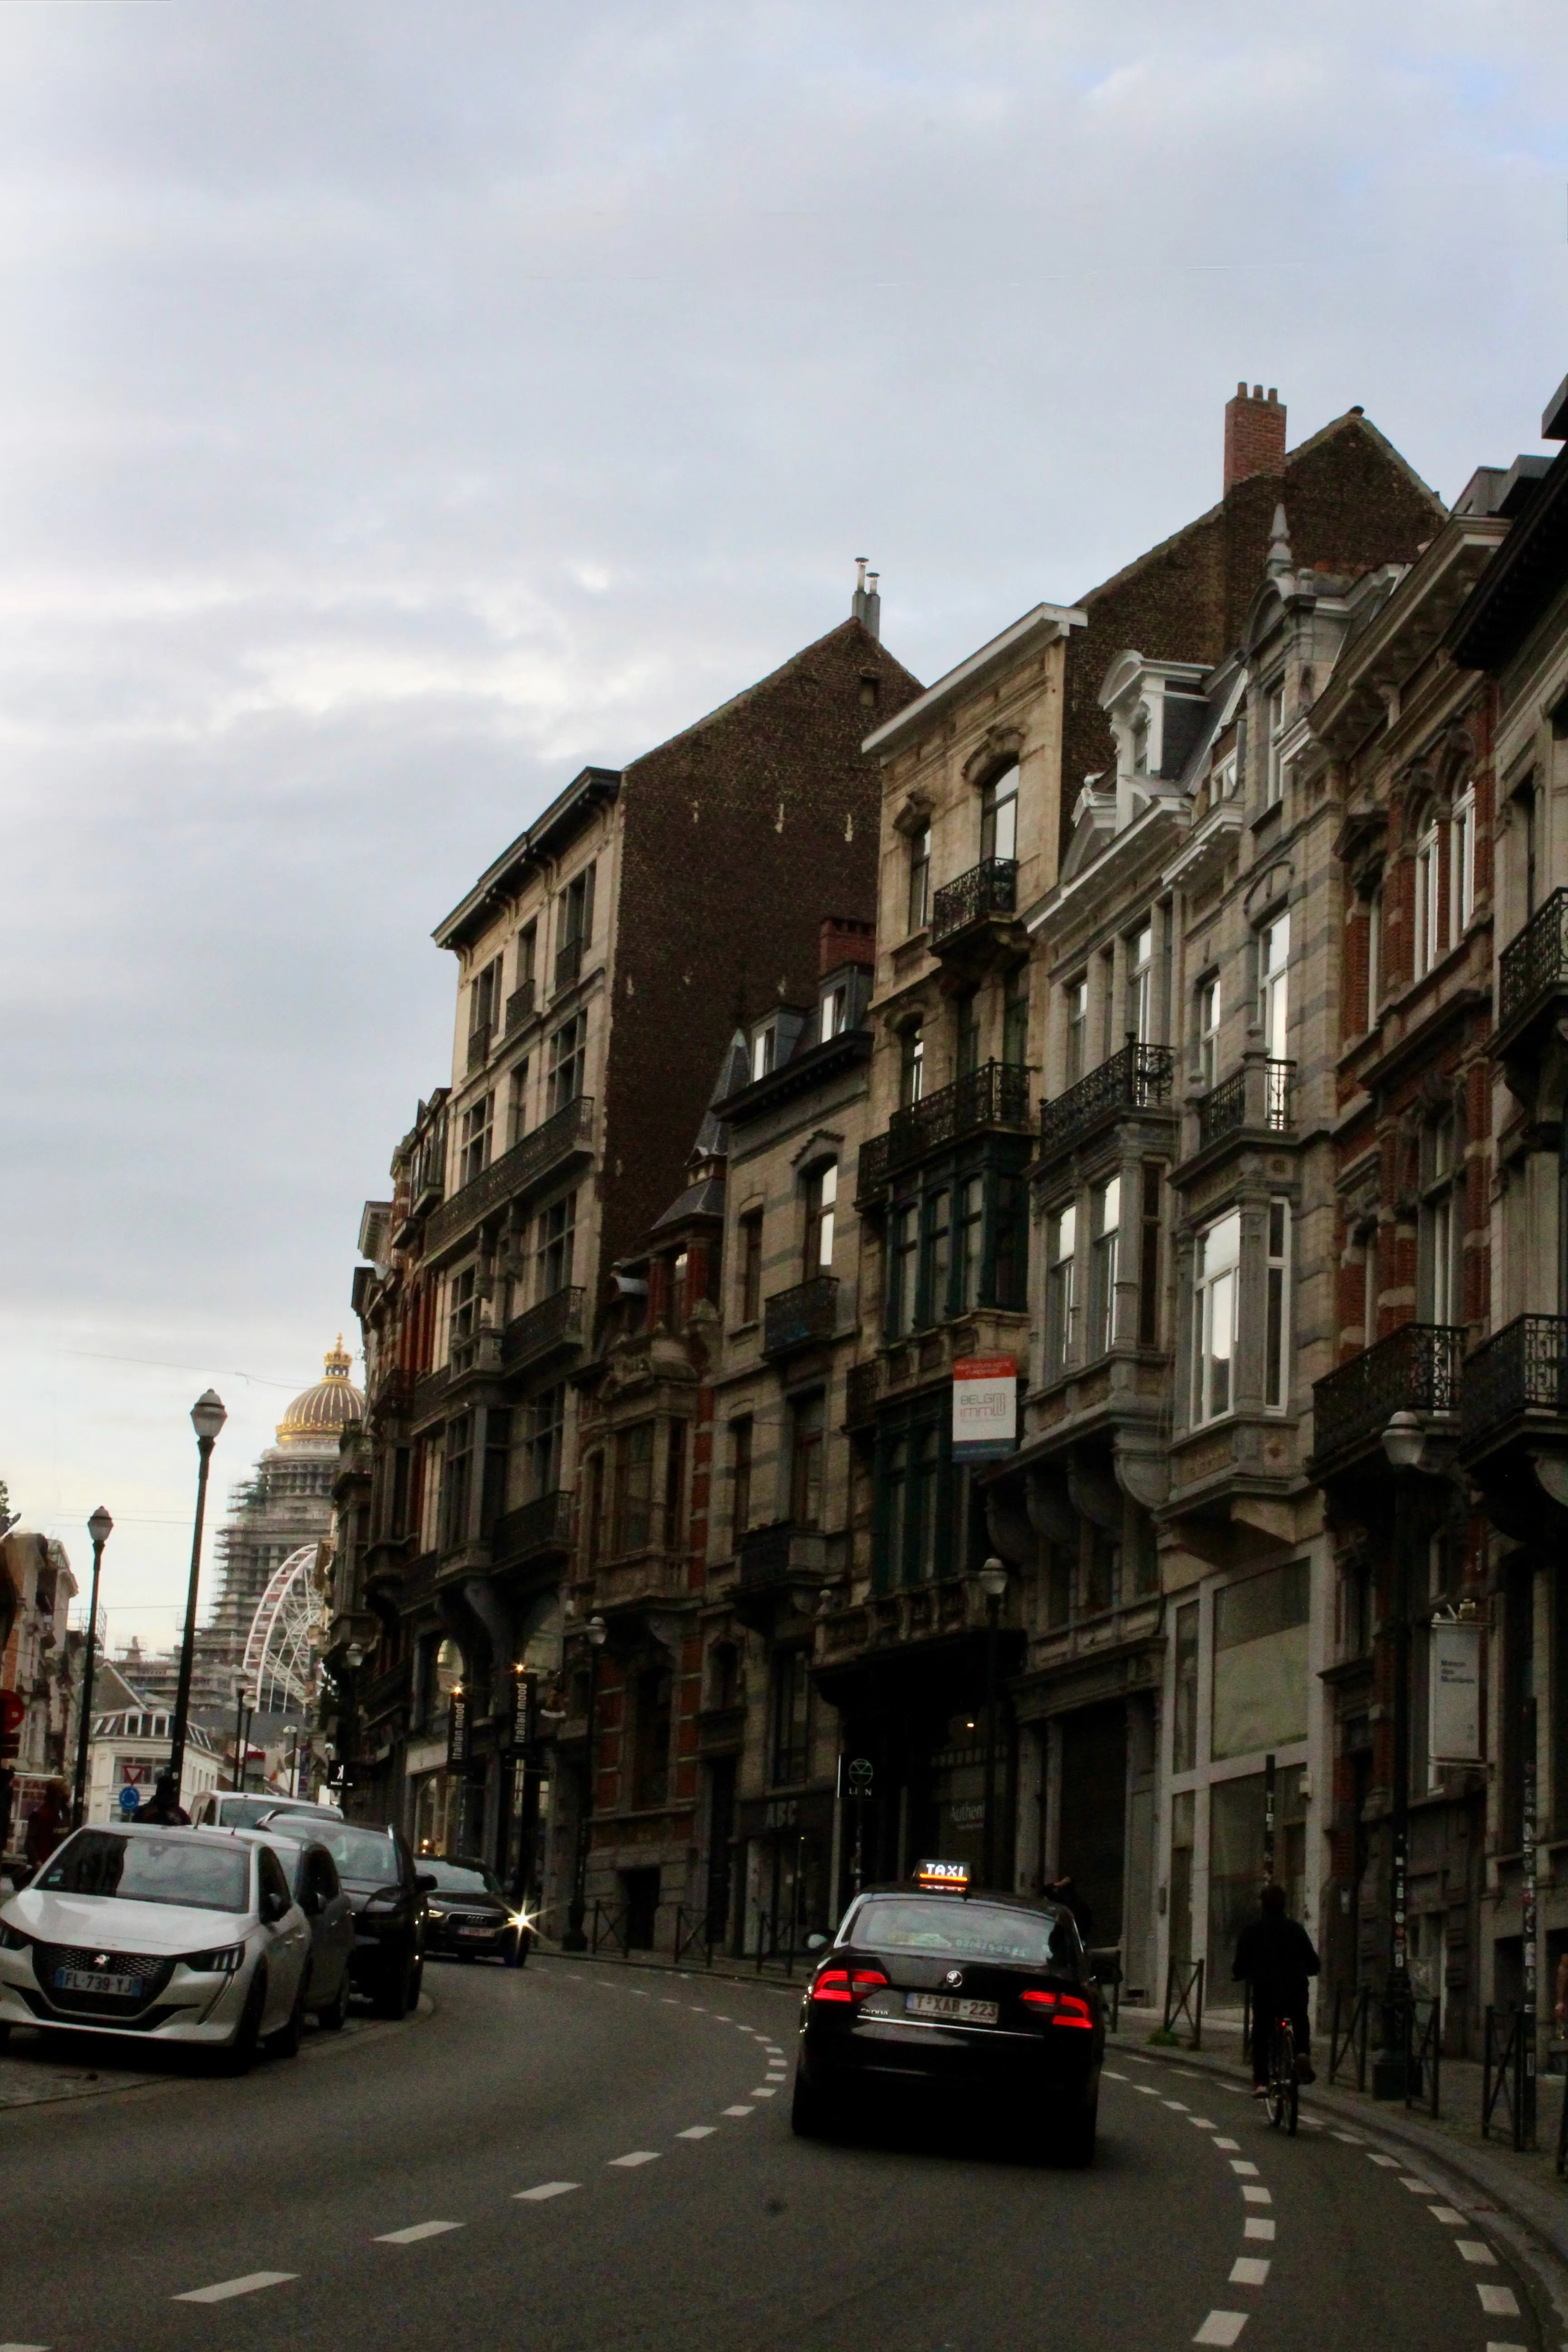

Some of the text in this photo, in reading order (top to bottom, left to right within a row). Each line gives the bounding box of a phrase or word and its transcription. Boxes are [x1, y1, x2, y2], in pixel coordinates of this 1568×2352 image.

[516, 1683, 528, 1710] mood
[455, 1703, 465, 1728] mood
[848, 1787, 872, 1796] LIN
[926, 1863, 964, 1877] TAXI
